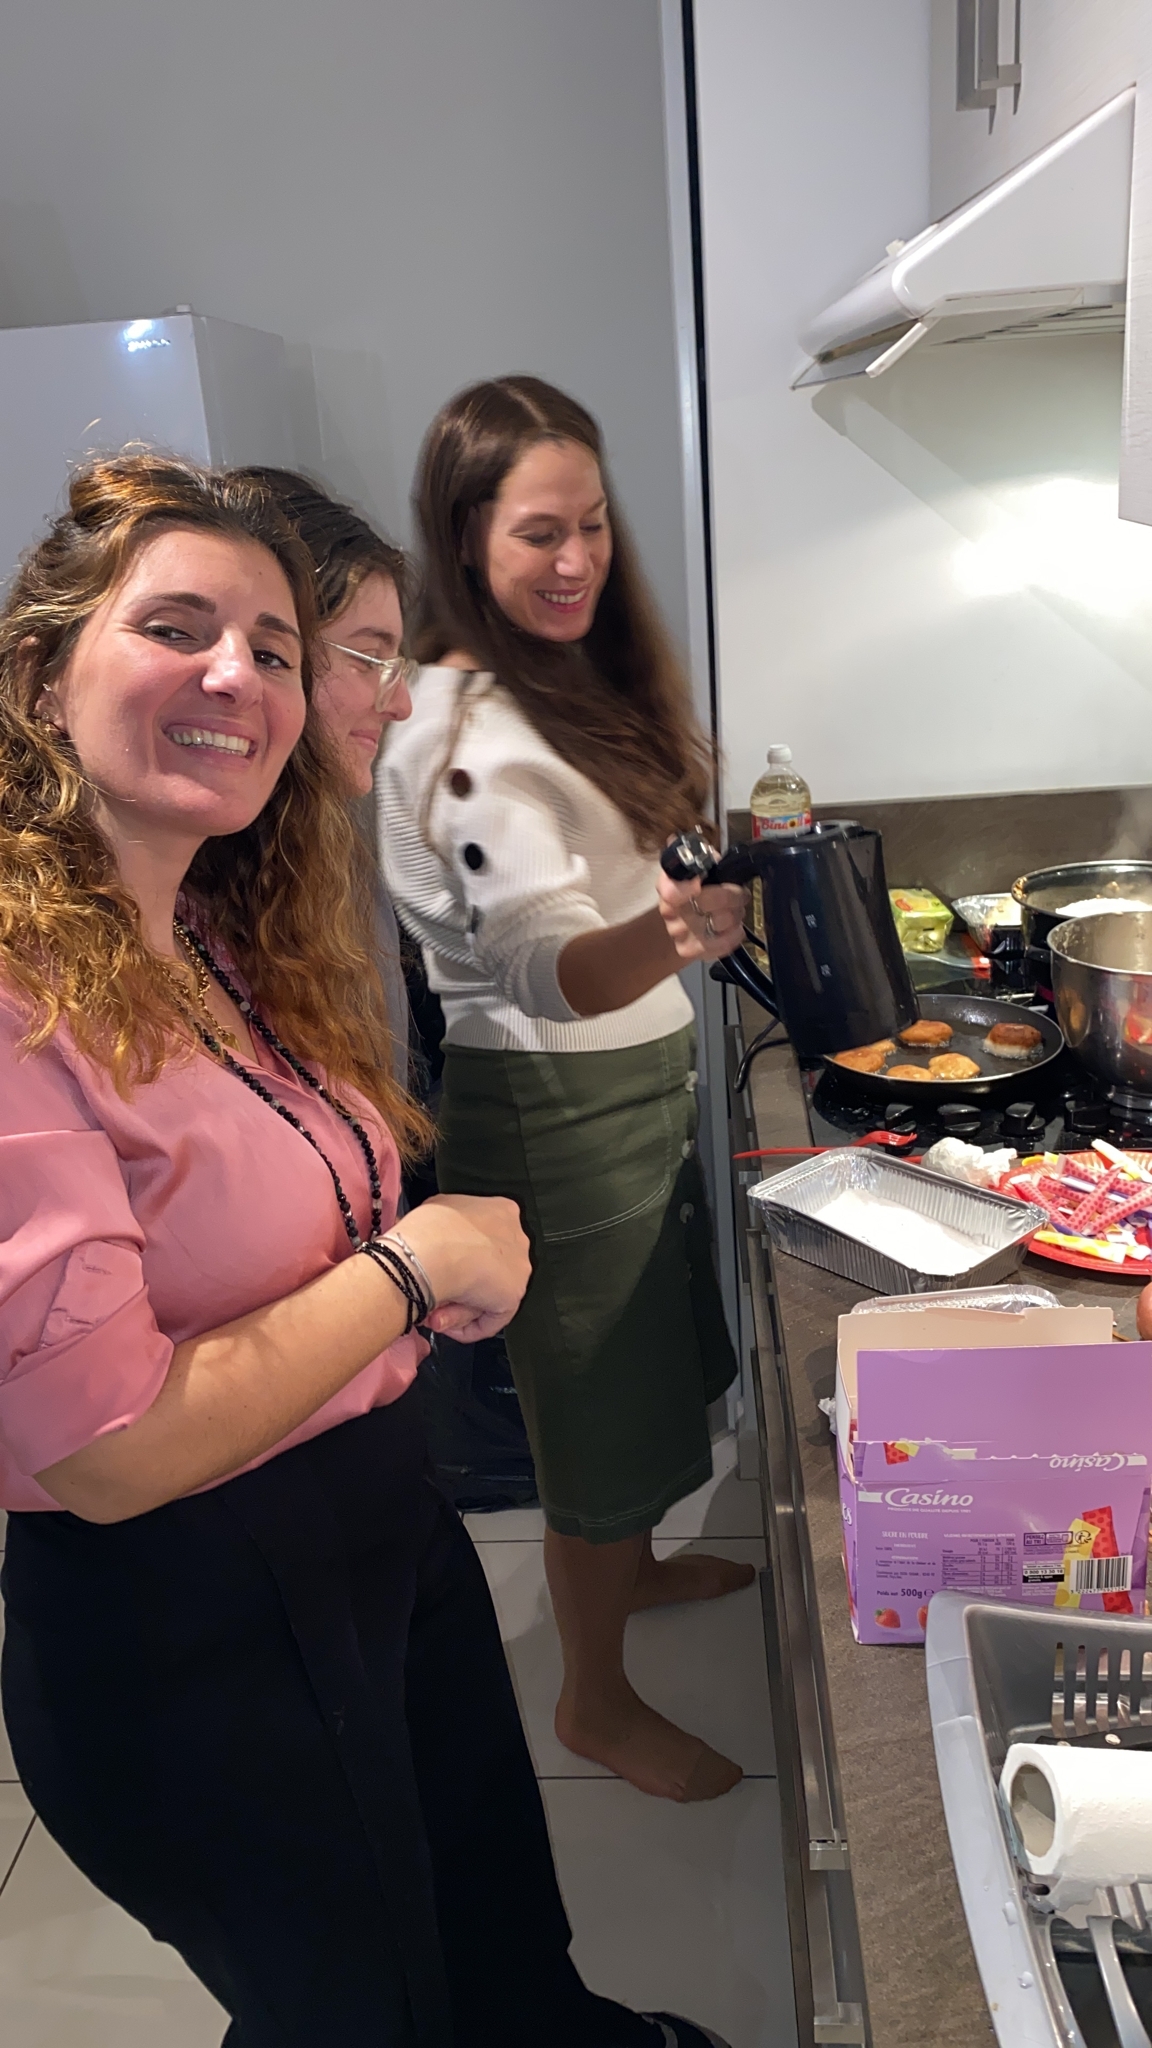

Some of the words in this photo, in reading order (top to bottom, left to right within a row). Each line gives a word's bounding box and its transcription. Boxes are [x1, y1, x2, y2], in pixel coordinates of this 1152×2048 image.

[1049, 1454, 1125, 1472] Casino
[884, 1488, 973, 1507] Casino
[901, 1588, 923, 1599] 500g
